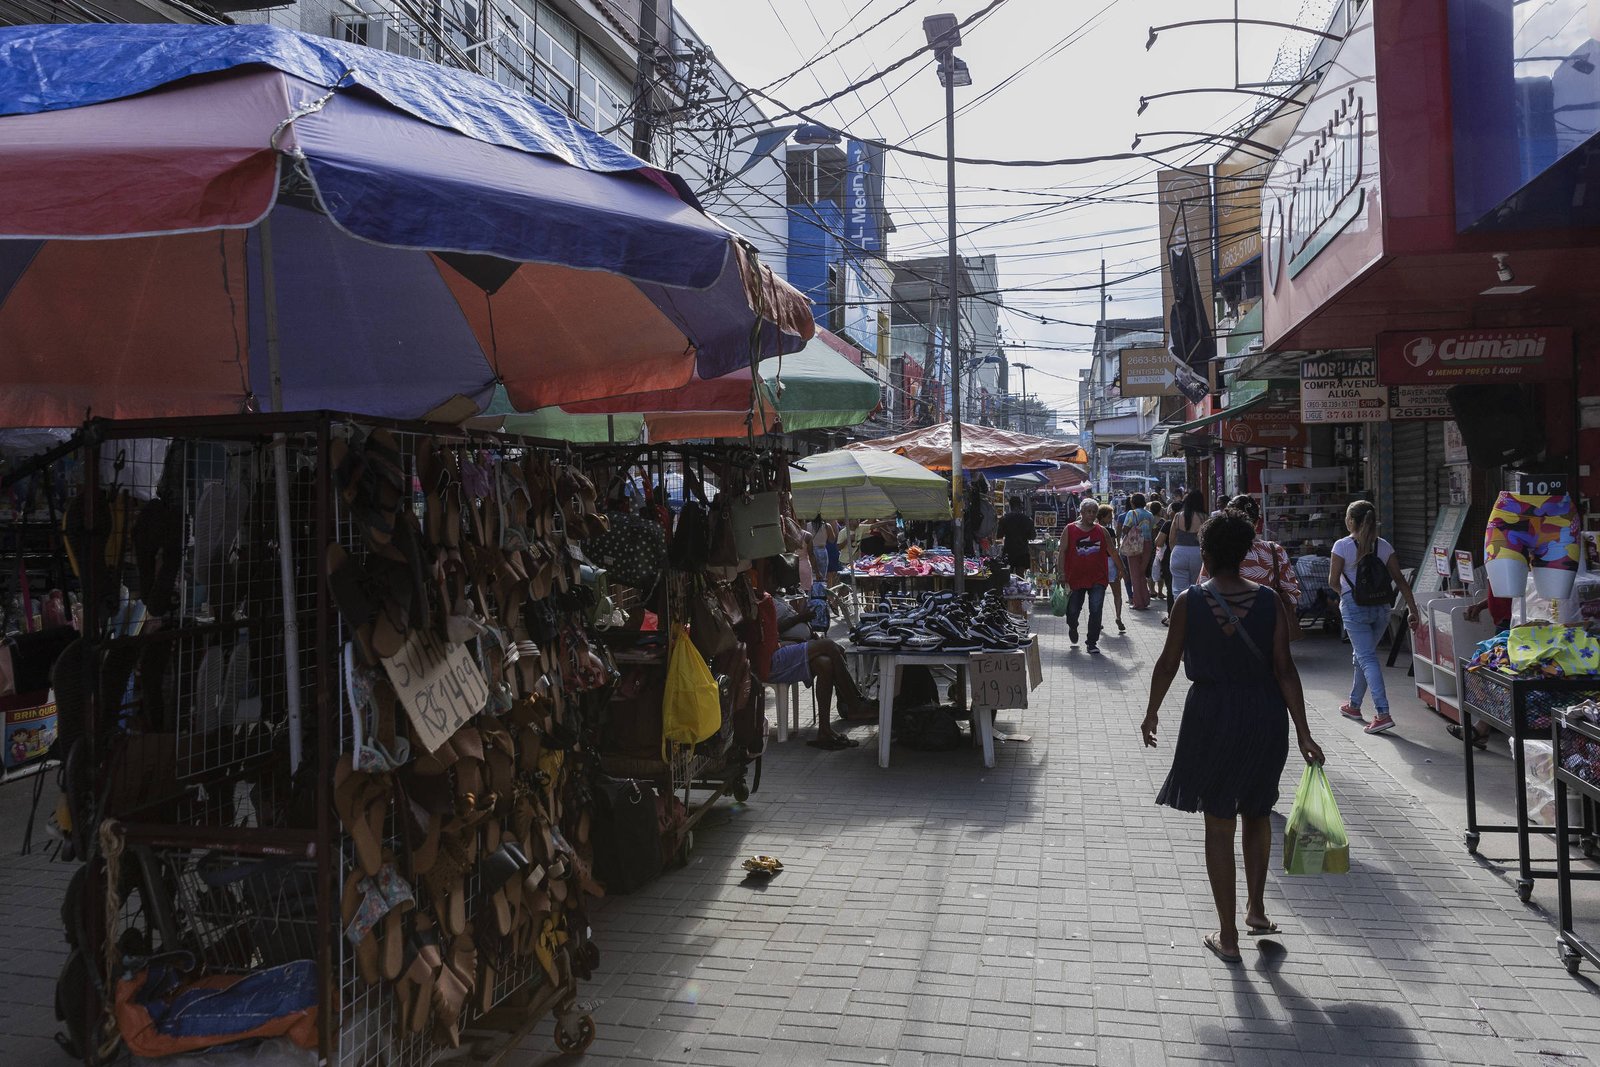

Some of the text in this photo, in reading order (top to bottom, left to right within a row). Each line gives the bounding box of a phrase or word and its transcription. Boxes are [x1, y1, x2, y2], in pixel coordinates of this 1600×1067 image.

[1438, 336, 1547, 361] Cumani
[1127, 355, 1173, 365] 2663-5100
[1127, 368, 1164, 376] DENTISTAS
[1303, 359, 1375, 378] IMOBILIÁRI
[1427, 369, 1434, 377] O
[1435, 368, 1464, 376] MENOR
[1464, 367, 1490, 376] PREÇO
[1491, 366, 1497, 374] É
[1327, 389, 1362, 398] ALUGA
[1305, 411, 1323, 419] LIGUE
